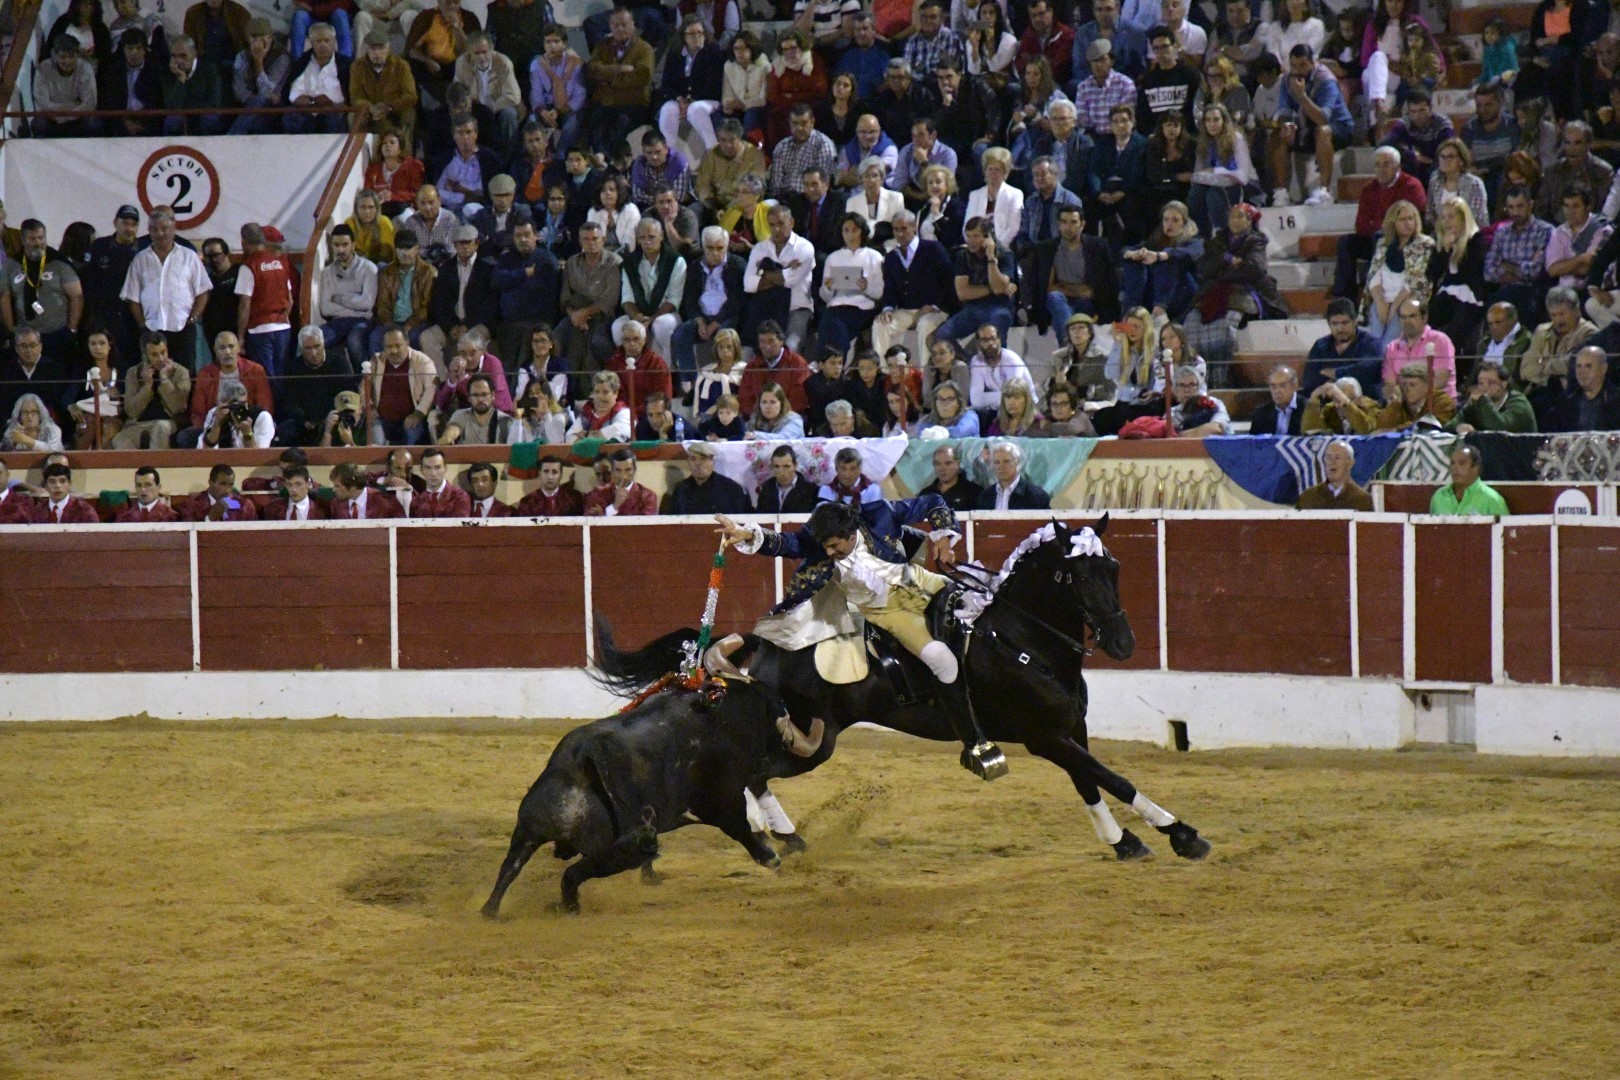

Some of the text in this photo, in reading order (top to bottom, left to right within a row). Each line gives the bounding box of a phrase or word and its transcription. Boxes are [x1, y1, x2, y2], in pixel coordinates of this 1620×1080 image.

[151, 157, 204, 180] SECTOR
[166, 173, 193, 214] 2
[1278, 215, 1296, 230] 16
[1557, 506, 1588, 515] ARTISTAS
